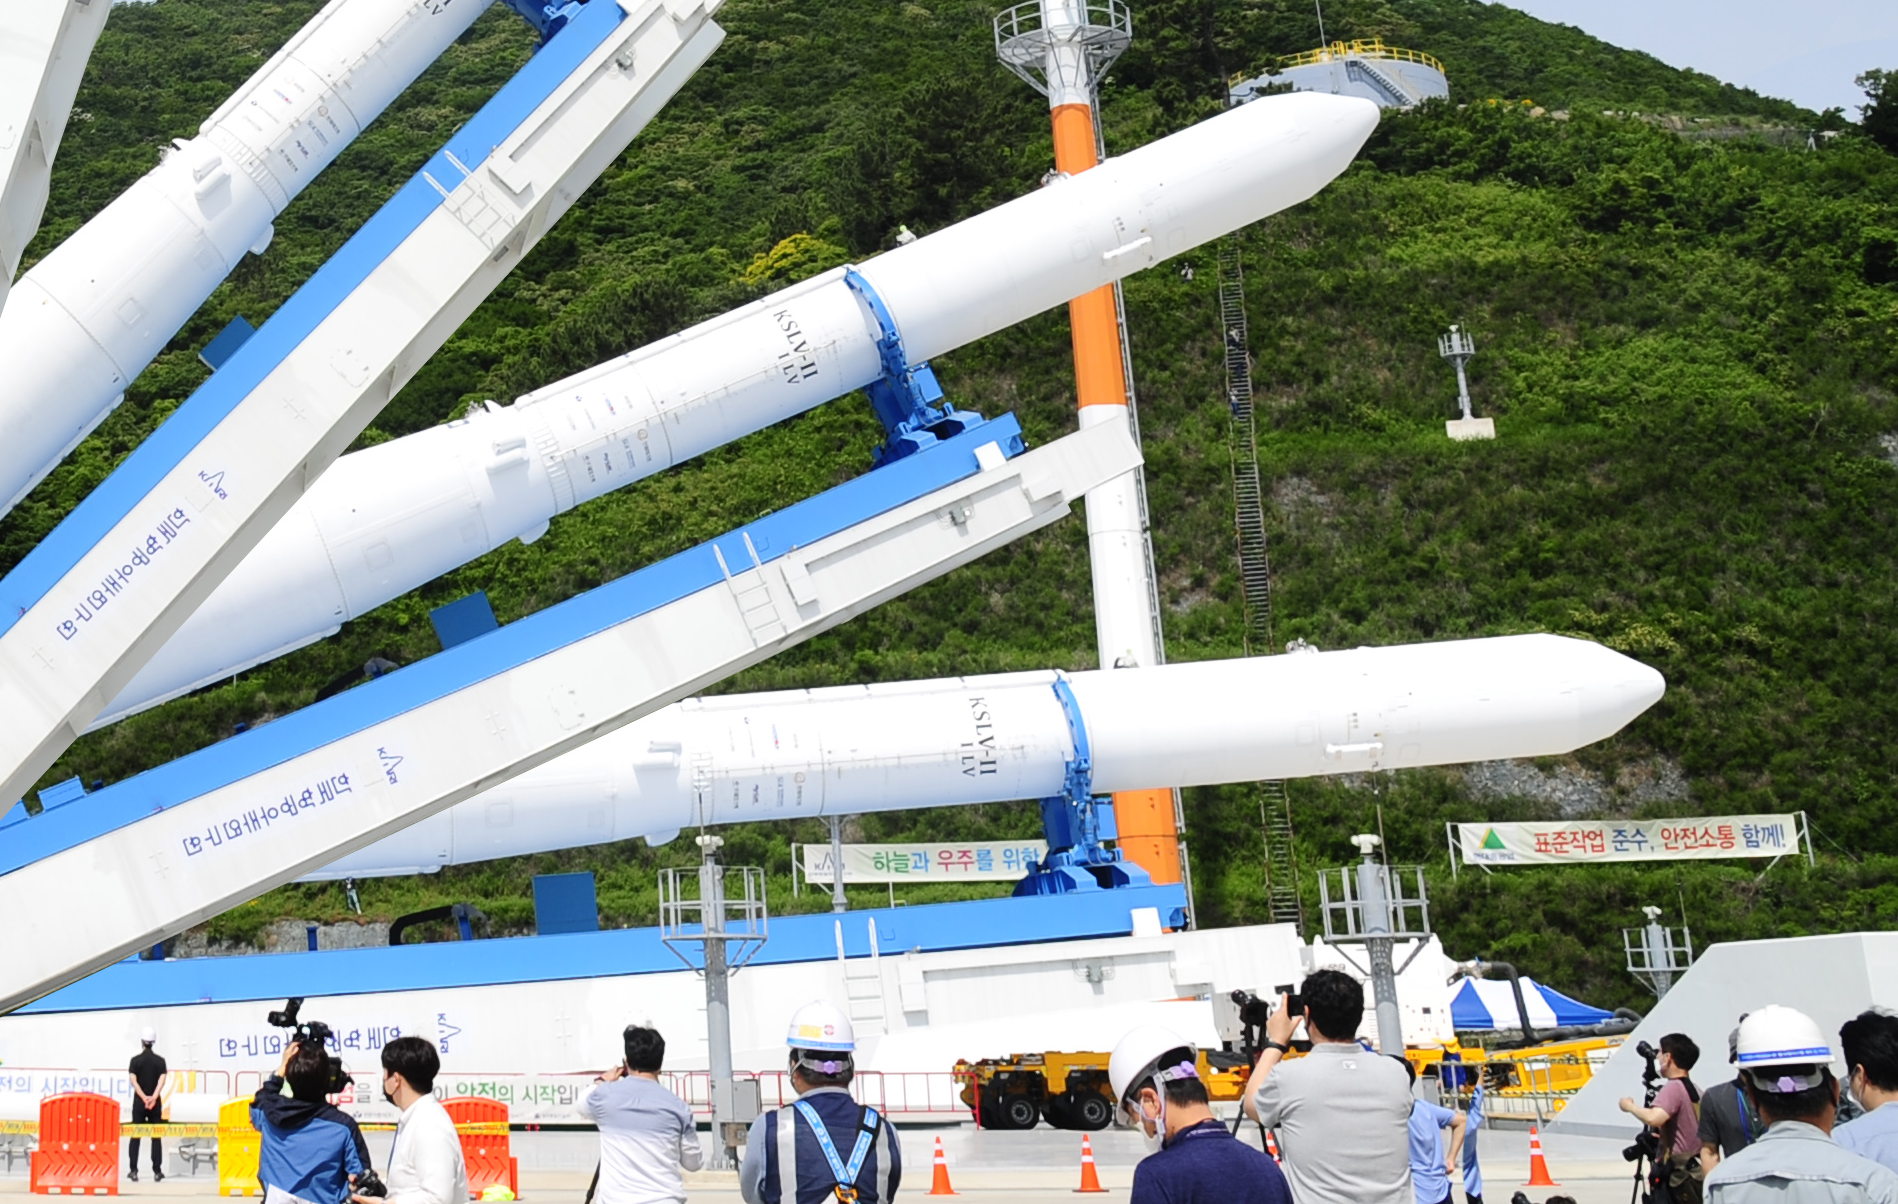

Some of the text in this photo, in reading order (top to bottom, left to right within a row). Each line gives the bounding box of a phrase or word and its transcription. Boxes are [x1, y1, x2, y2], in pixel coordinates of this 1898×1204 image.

[773, 309, 818, 379] KSLV-II
[198, 471, 228, 500] KARI
[56, 507, 190, 641] 한국항공우주연구원
[969, 697, 997, 775] KSLV-II
[377, 747, 404, 785] KARI
[182, 772, 352, 856] 한국항공우주연구원
[1534, 823, 1786, 854] 표준작업 준수, 안전소통 함께!
[872, 851, 930, 874] 하늘과
[937, 849, 994, 872] 우주를
[219, 1026, 401, 1058] 한국항공연구원
[438, 1013, 462, 1054] KARI
